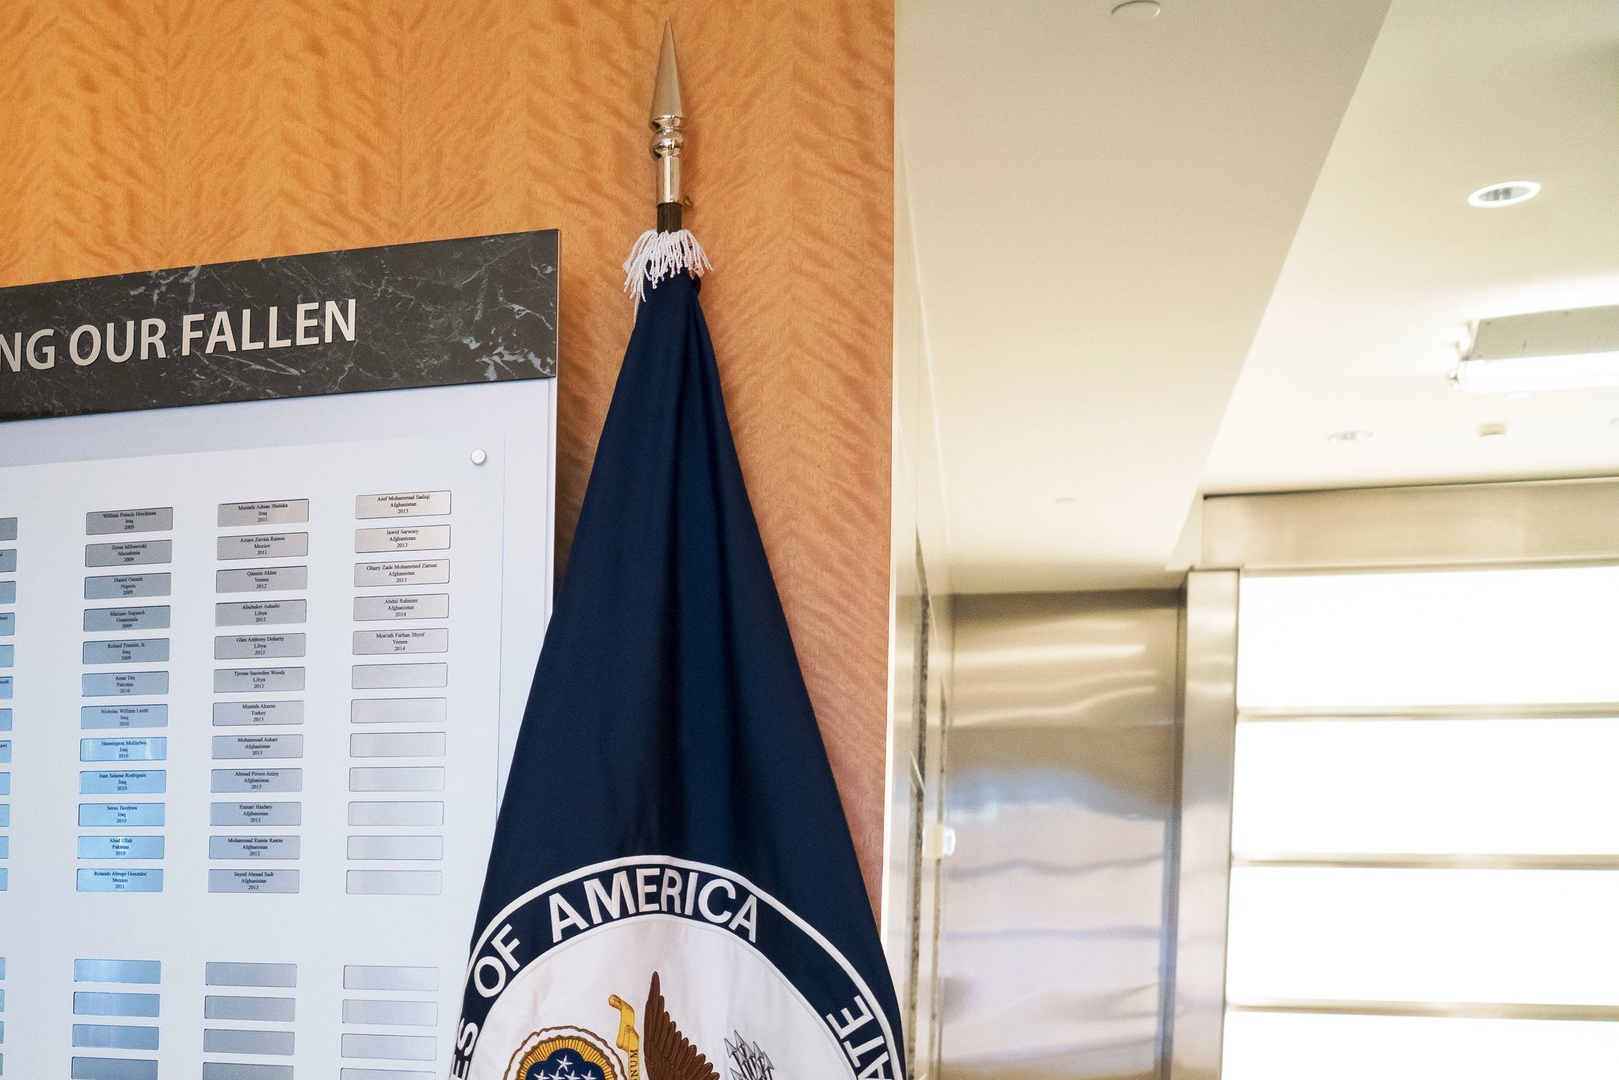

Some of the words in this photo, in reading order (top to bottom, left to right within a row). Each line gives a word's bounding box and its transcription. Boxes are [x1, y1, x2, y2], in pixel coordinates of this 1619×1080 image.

[69, 316, 169, 365] OUR
[181, 298, 357, 357] FALLEN
[475, 924, 522, 998] OF
[549, 867, 759, 944] AMERICA
